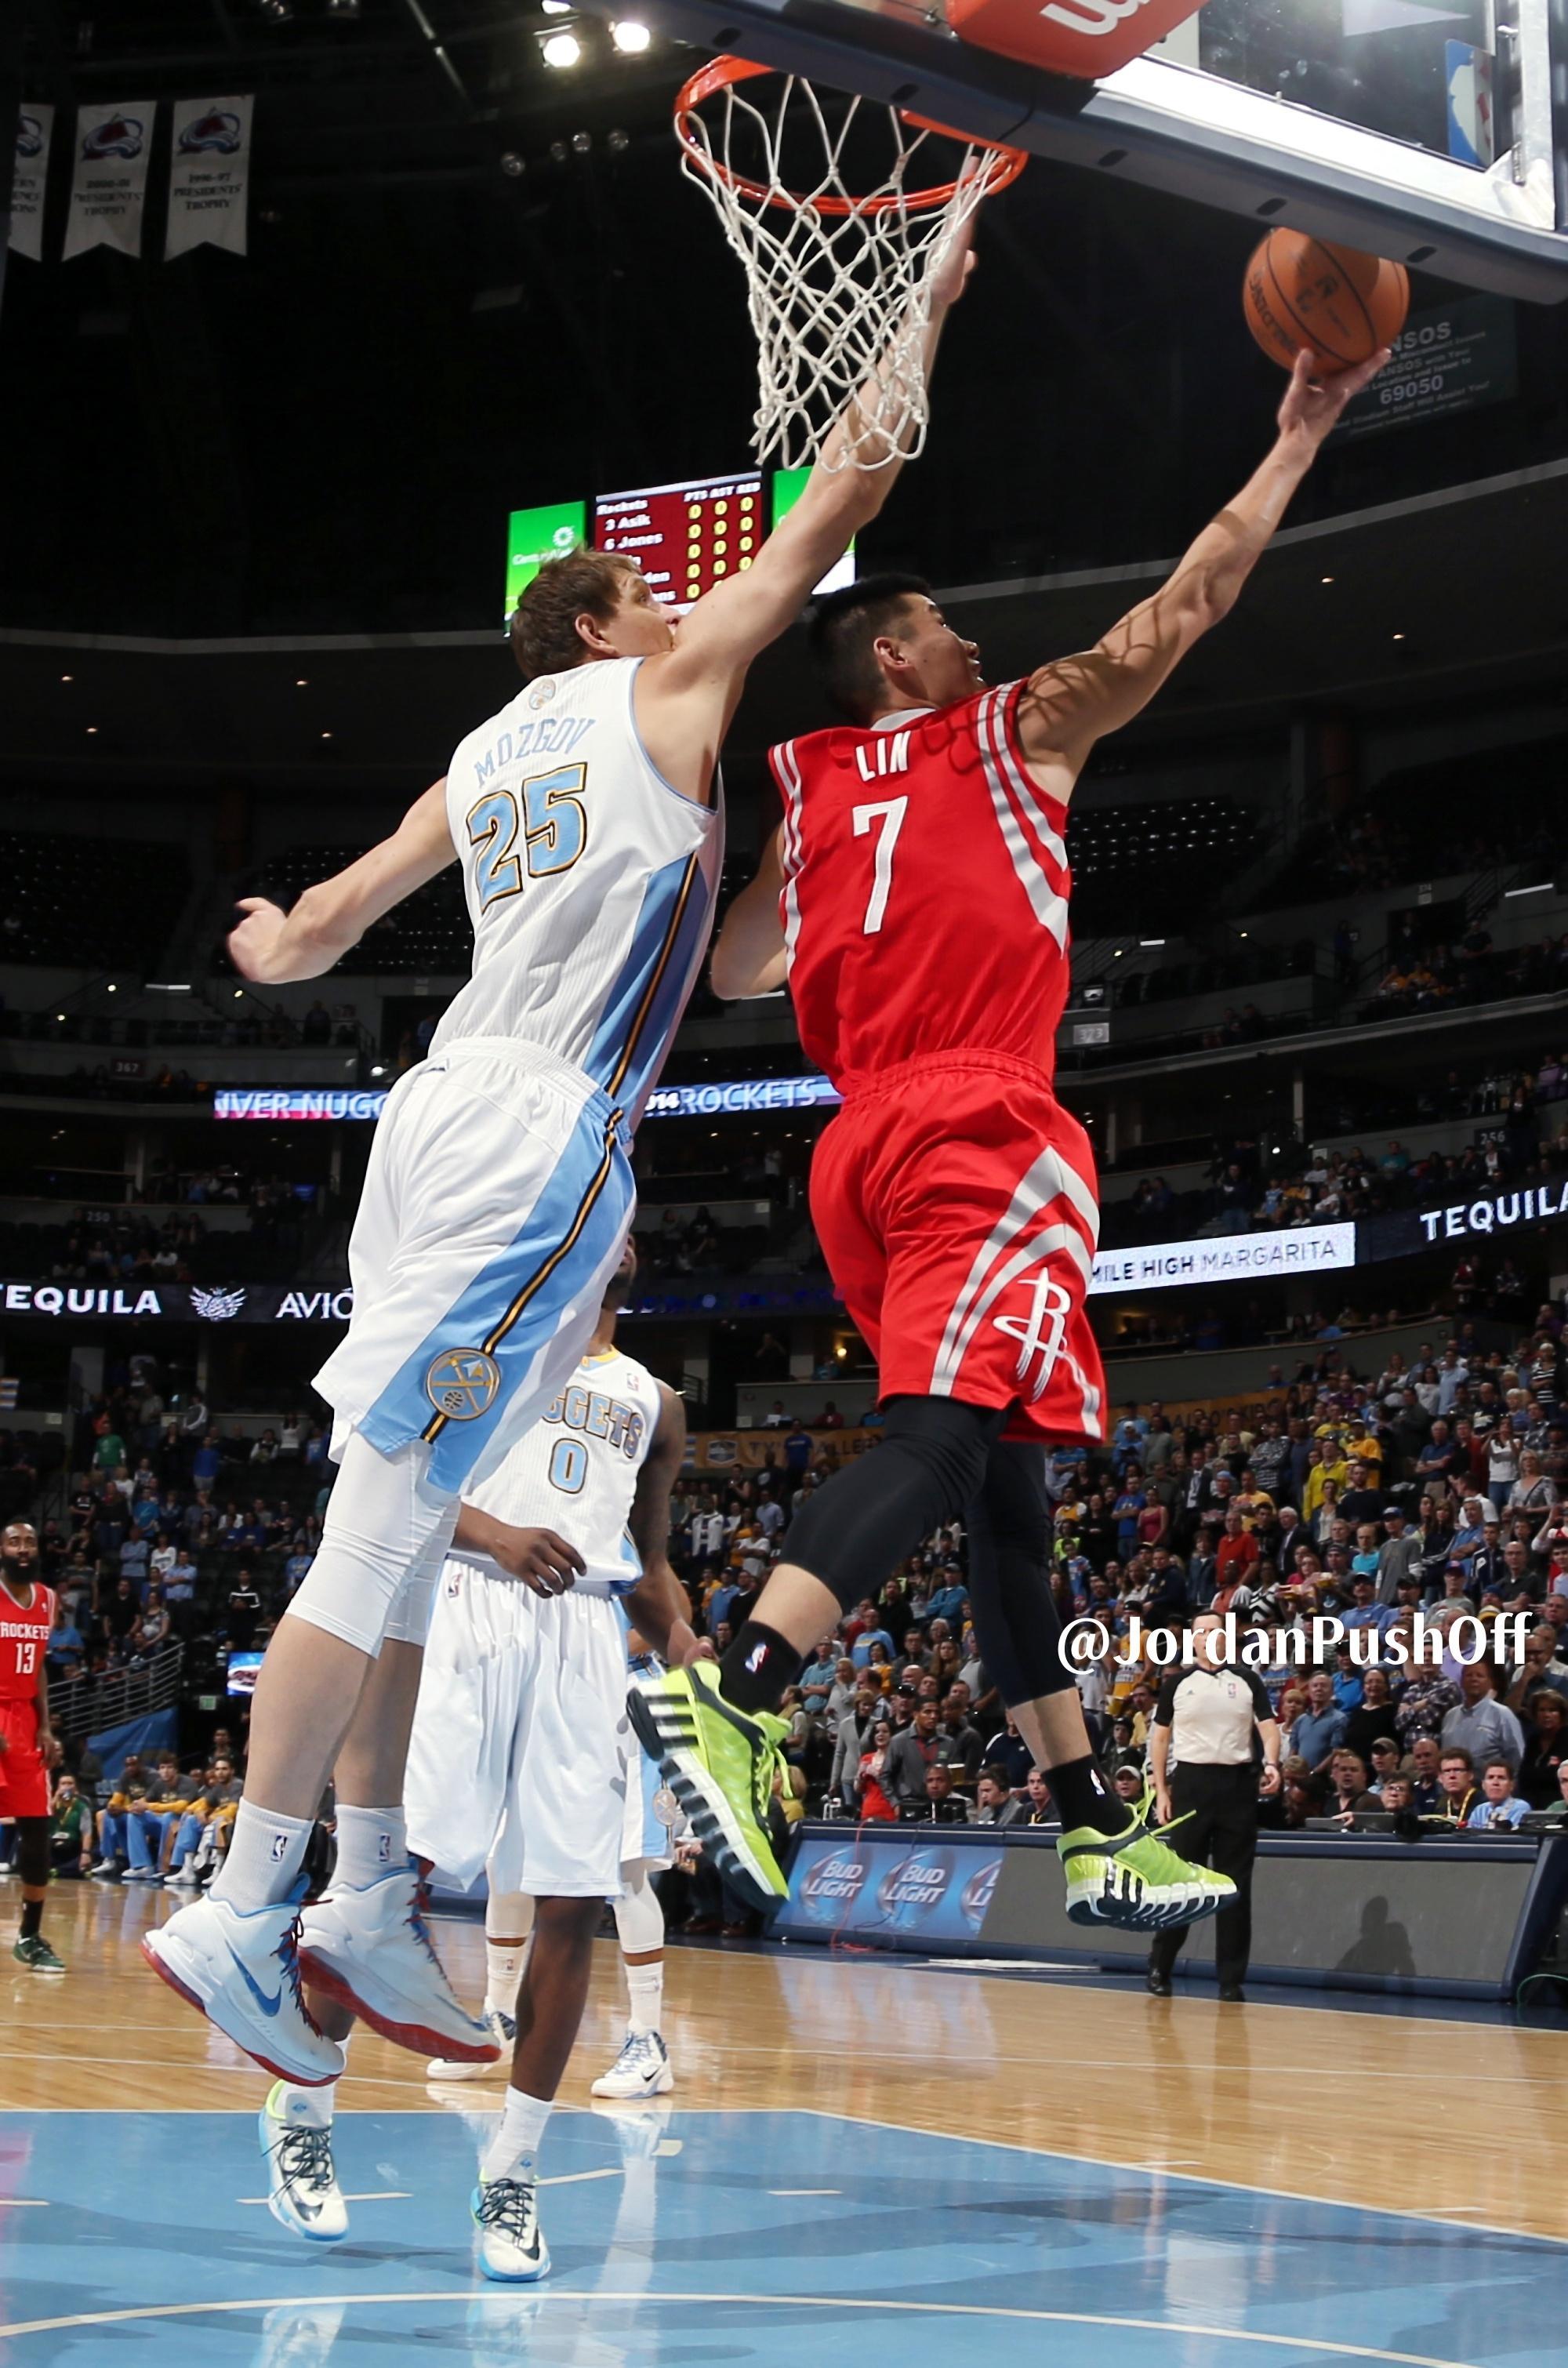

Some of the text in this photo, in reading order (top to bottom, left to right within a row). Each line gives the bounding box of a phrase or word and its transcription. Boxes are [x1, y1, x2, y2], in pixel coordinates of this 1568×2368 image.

[186, 198, 230, 210] TROPHY
[1380, 374, 1443, 405] 69050
[688, 496, 753, 519] 0 0 0
[617, 514, 652, 529] Asik
[617, 533, 663, 549] Jones
[474, 717, 596, 788] MOZGOV
[855, 730, 911, 782] LIN
[466, 761, 587, 915] 25
[851, 794, 909, 935] 7
[114, 1062, 141, 1073] 367
[680, 1079, 817, 1114] ROCKETS
[1479, 1130, 1506, 1146] 256
[1143, 1253, 1193, 1277] HIGH
[1201, 1239, 1335, 1272] MARGARITA
[548, 1438, 588, 1494] 0
[0, 1621, 49, 1640] ROCKETS
[15, 1643, 36, 1674] 13
[822, 1860, 863, 1880] BUD
[901, 1864, 946, 1884] BUD
[806, 1879, 863, 1898] LIGHT
[884, 1883, 946, 1903] LIGHT
